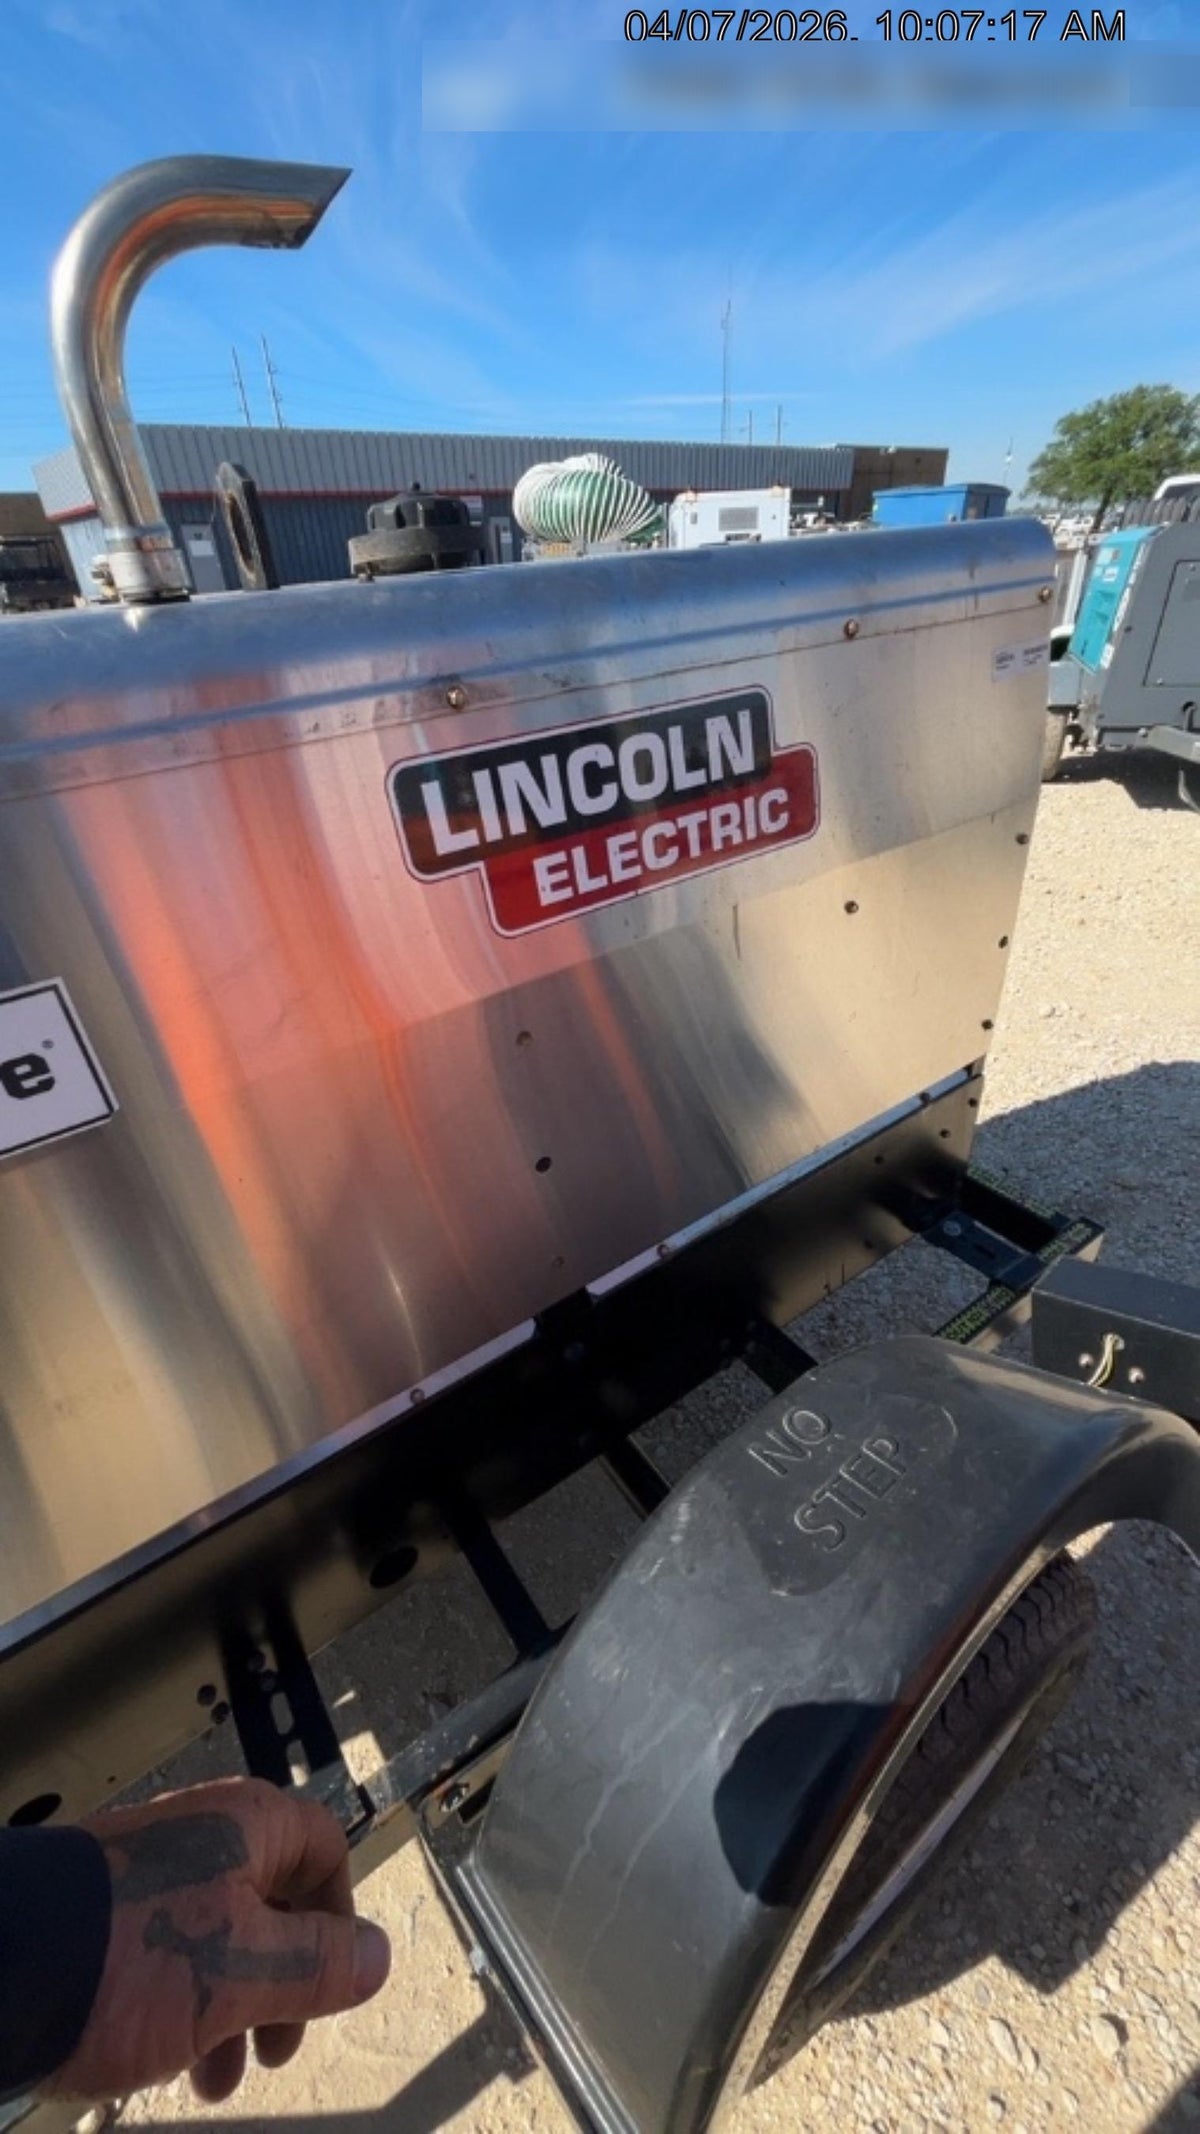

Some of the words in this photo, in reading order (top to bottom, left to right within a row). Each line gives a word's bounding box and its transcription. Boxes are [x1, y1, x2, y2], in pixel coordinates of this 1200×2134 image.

[421, 709, 757, 856] LINCOLN
[532, 788, 789, 906] ELECTRIC
[748, 1407, 831, 1477] NO
[794, 1436, 906, 1551] STEP
